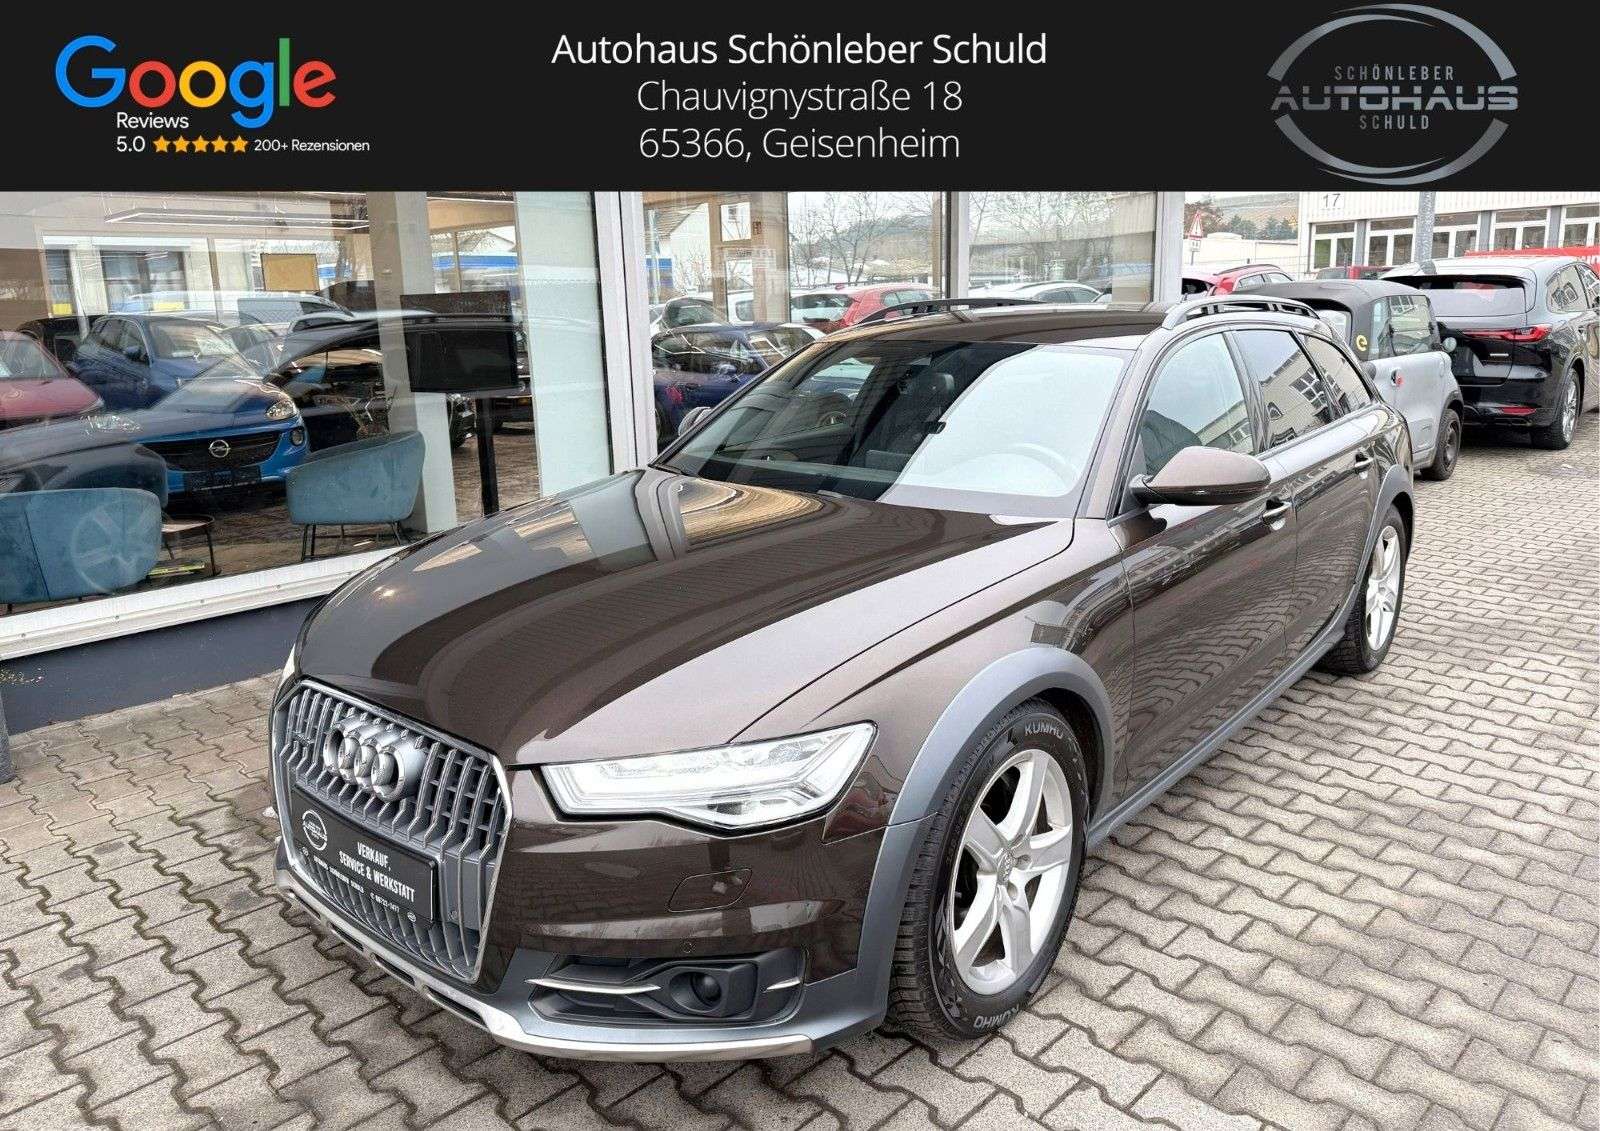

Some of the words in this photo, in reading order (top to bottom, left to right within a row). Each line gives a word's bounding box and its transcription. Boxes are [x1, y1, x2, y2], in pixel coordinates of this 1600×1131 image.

[1323, 193, 1341, 208] 17
[1025, 721, 1063, 739] KUMHO
[339, 850, 365, 877] SERVICE
[366, 866, 372, 880] &
[373, 869, 415, 902] WERKSTATT
